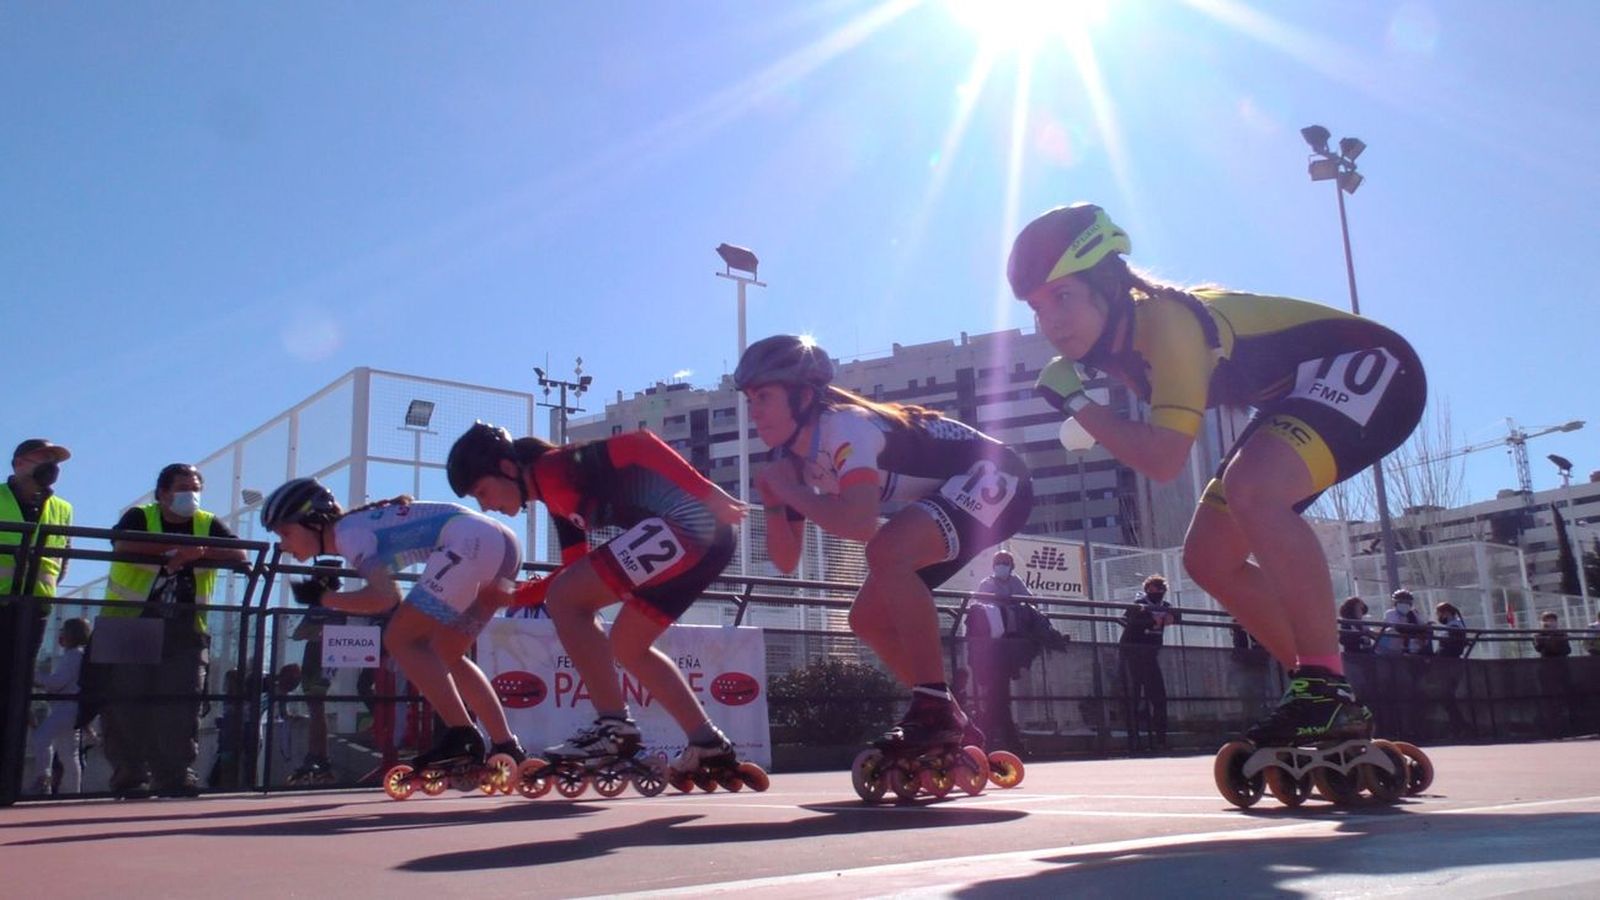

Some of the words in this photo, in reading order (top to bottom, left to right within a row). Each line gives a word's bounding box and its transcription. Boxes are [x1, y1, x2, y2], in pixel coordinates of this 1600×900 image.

[1308, 382, 1350, 404] FMP
[961, 464, 1008, 505] 13
[955, 493, 982, 512] FMP
[618, 549, 638, 572] FMP
[628, 524, 677, 575] 12
[434, 550, 463, 580] 7
[1026, 571, 1082, 593] kkeron
[327, 638, 375, 647] ENTRADA
